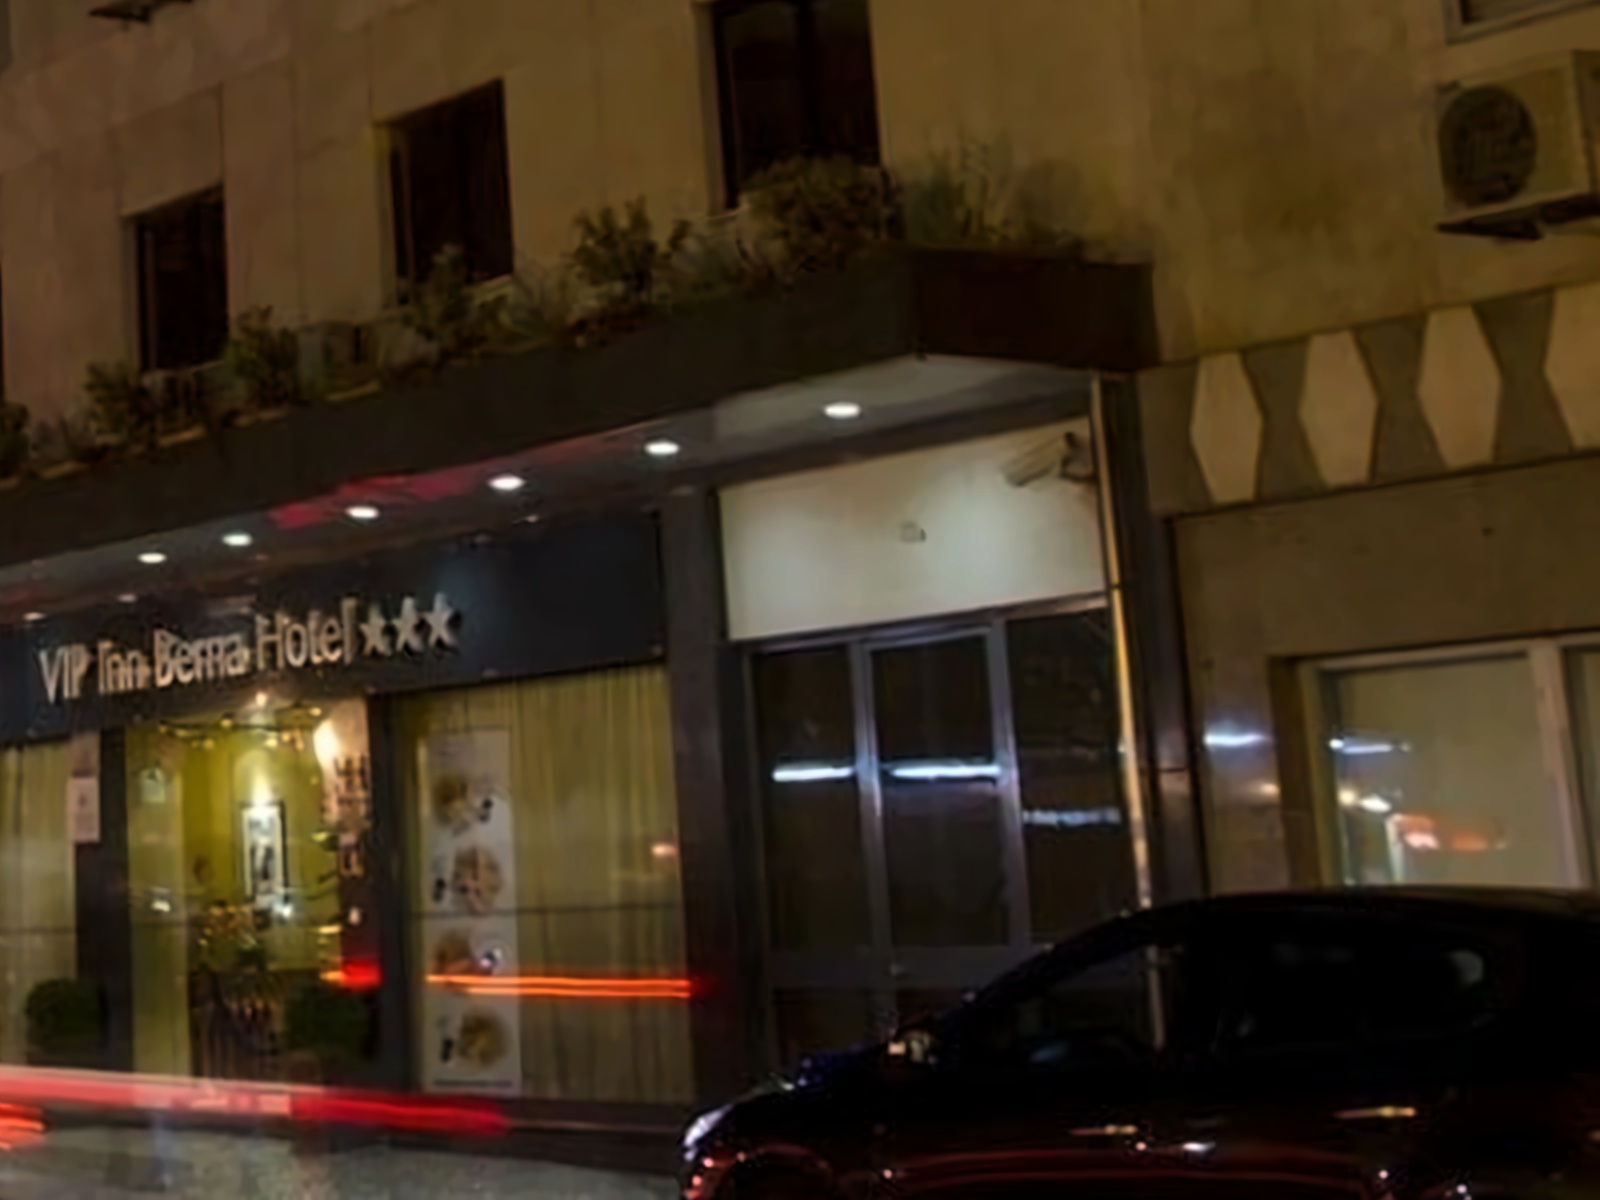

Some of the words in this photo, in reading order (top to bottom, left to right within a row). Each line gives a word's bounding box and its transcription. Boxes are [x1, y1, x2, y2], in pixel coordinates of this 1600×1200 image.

[40, 642, 90, 704] VIP
[97, 638, 151, 695] Inn
[153, 627, 250, 688] Berna
[255, 597, 357, 671] Hotel
